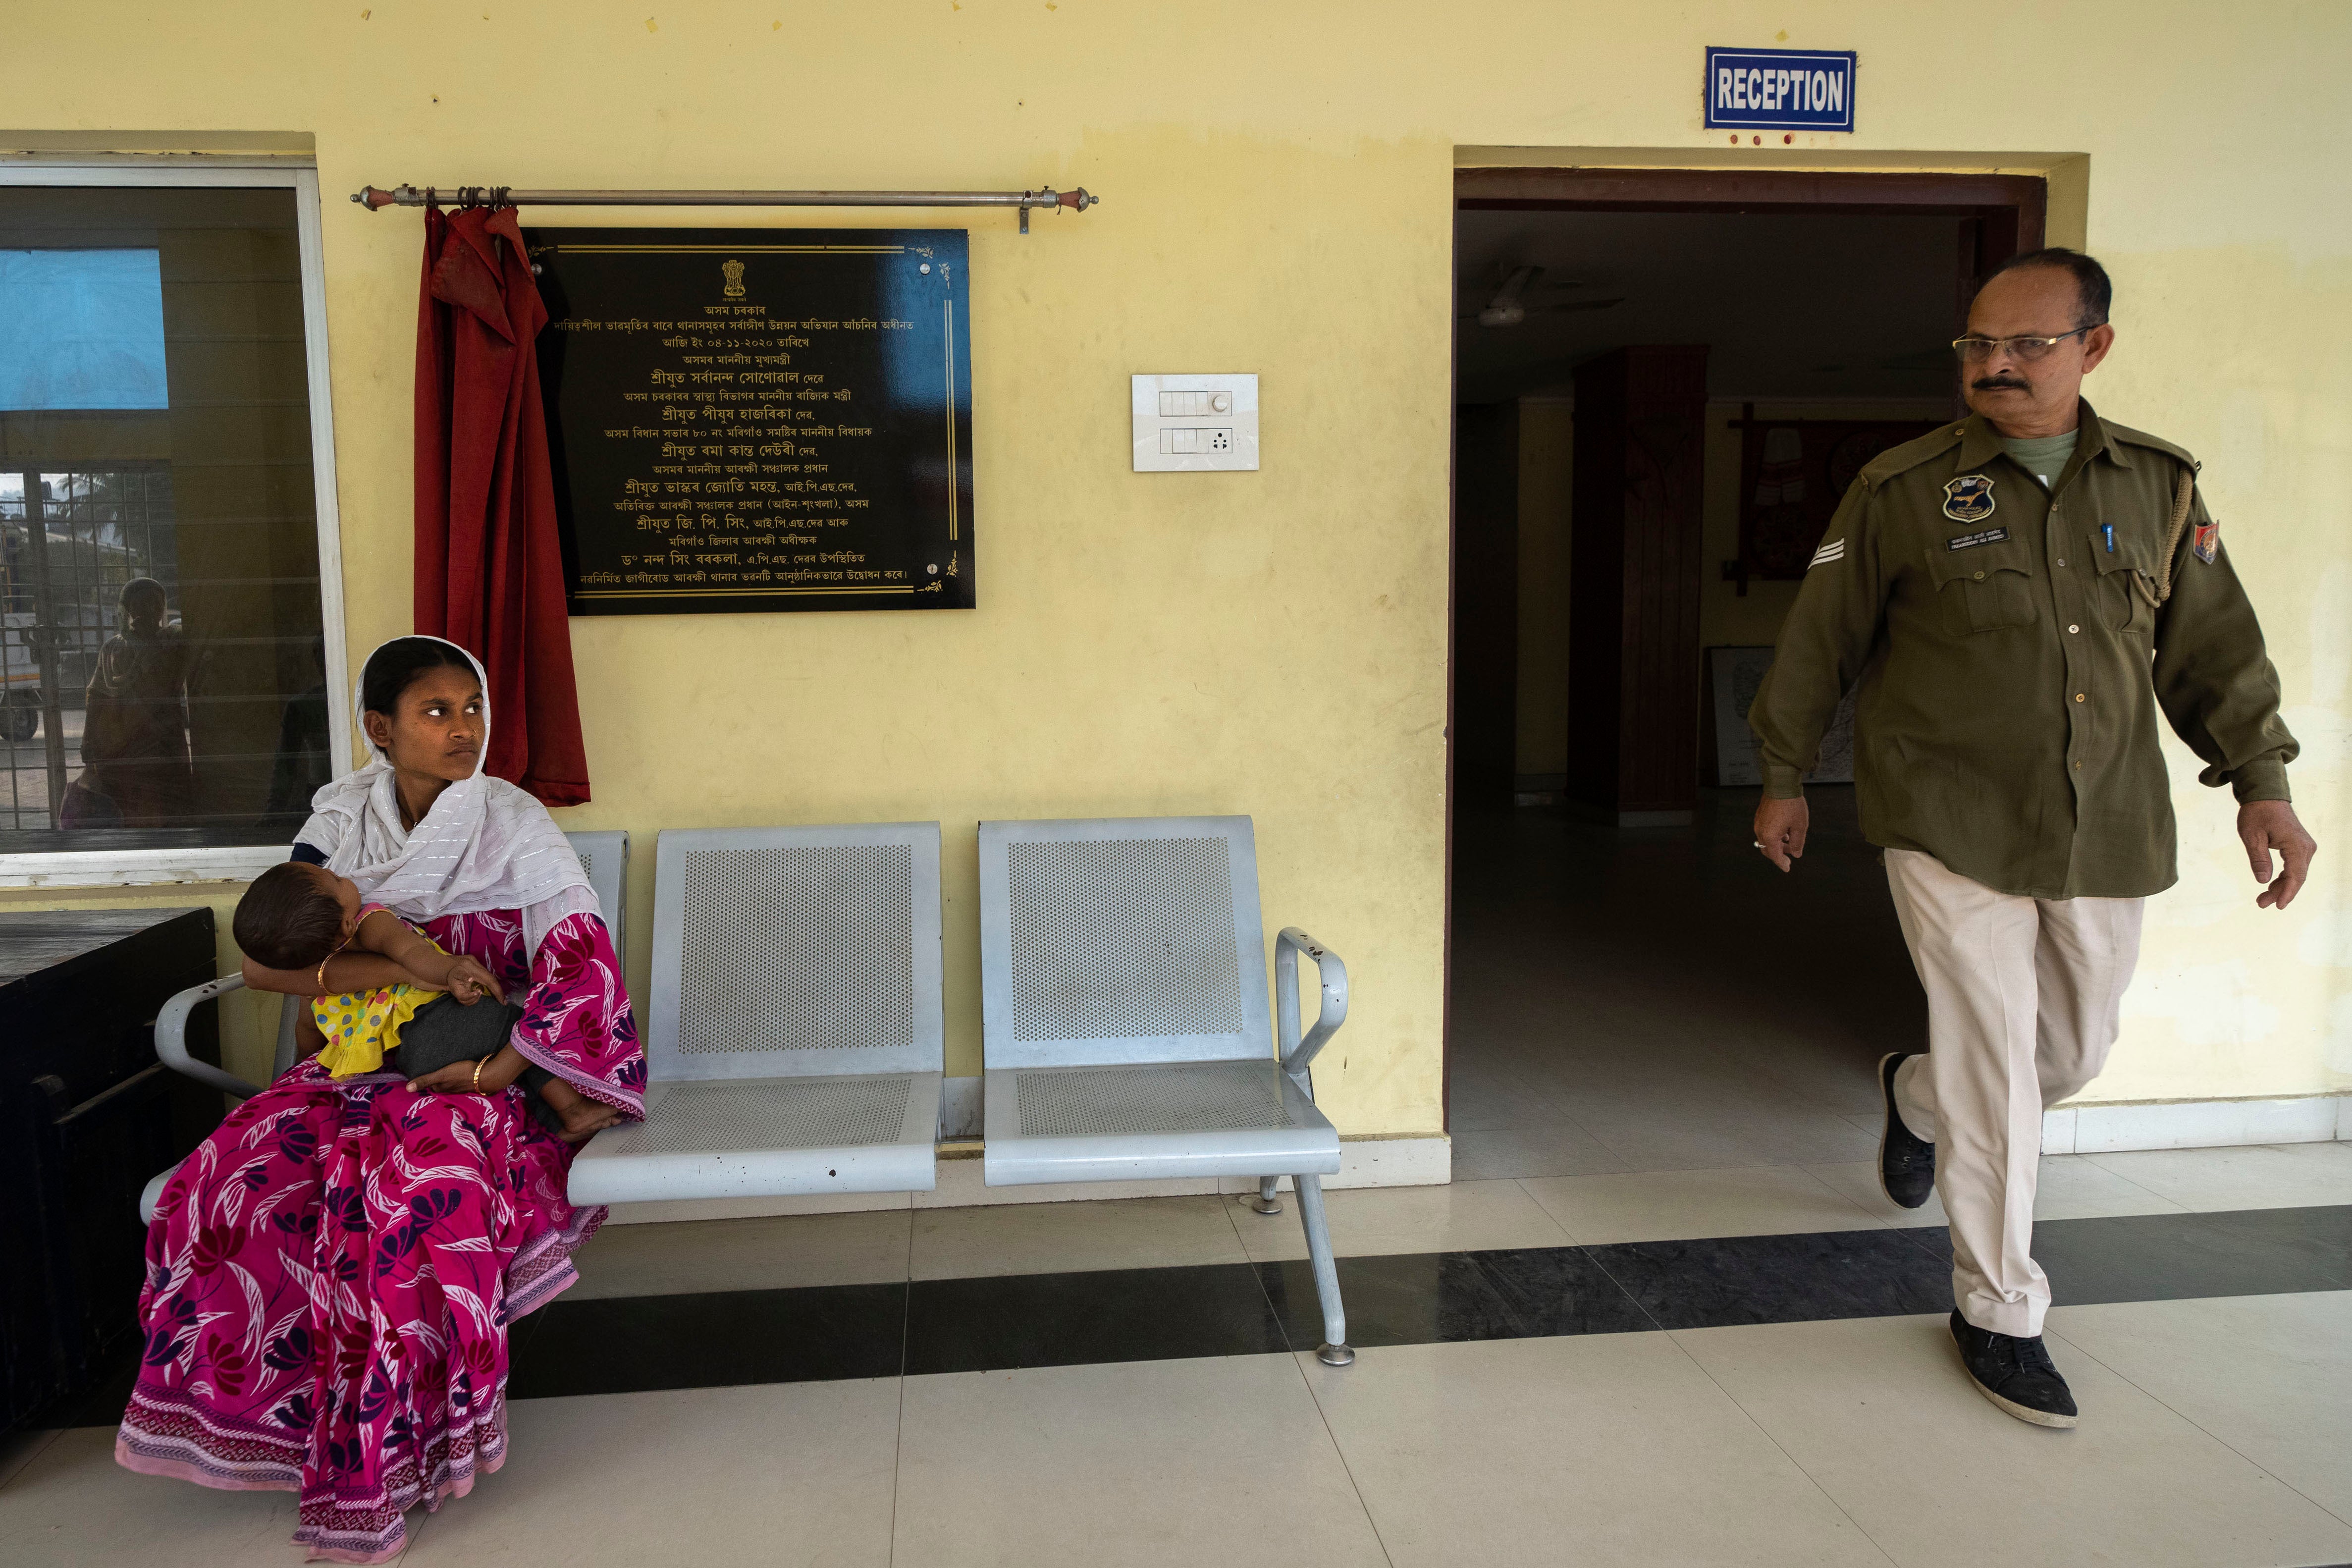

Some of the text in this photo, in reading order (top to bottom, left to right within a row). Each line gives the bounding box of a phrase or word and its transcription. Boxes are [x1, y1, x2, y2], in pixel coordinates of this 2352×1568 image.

[1717, 68, 1844, 111] RECEPTION
[703, 305, 766, 316] অসম চৰকাৰ
[604, 318, 649, 334] ভাৱমূৰ্তিৰ
[677, 321, 725, 334] থানাসমূহৰ
[767, 319, 797, 330] উন্নয়ন
[800, 318, 839, 330] অভিযান
[841, 318, 877, 330] আঁচনিৰ
[880, 318, 914, 330] অধীনত
[662, 334, 809, 349] আজি ইং ০৪-১১-২০২০ তাৰিখে
[682, 352, 791, 368] অসমৰ মাননীয় মুখ্যমন্ত্ৰী
[650, 369, 686, 388] শ্ৰীযুত
[690, 369, 734, 384] সৰ্বানন্দ
[739, 371, 800, 384] সোণোৱাল
[623, 388, 852, 402] অসম চৰকাৰৰ স্বাস্থ্য বিভাগৰ মাননীয় ৰাজ্যিক মন্ত্ৰী
[661, 405, 697, 425] শ্ৰীযুত
[738, 404, 792, 421] হাজৰিকা
[796, 411, 814, 421] দেৱ,
[603, 424, 872, 438] অসম বিধান সভাৰ ৮০ নং মৰিগাঁও সমষ্টিৰ মাননীয় বিধায়ক
[661, 440, 818, 461] শ্ৰীযুত ৰমা কান্ত দেউৰী দেৱ,
[651, 466, 683, 475] অসমৰ
[686, 462, 721, 475] মাননীয়
[724, 462, 758, 474] আৰক্ষী
[803, 463, 828, 473] প্ৰধান
[624, 479, 660, 498] শ্ৰীযুত
[663, 481, 700, 493] ভাস্কৰ
[705, 477, 745, 493] জ্যোতি
[748, 481, 780, 494] মহন্ত,
[613, 498, 655, 511] অতিৰিক্ত
[658, 498, 692, 511] আৰক্ষী
[738, 500, 763, 510] প্ৰধান
[844, 499, 869, 508] অসম
[636, 515, 671, 534] শ্ৰীযুত
[675, 514, 695, 530] জি.
[700, 513, 719, 530] পি.
[724, 513, 748, 530] সিং,
[826, 518, 849, 528] আৰু
[668, 533, 817, 547] মৰিগাঁও জিলাৰ আৰক্ষী অধীক্ষক
[642, 555, 665, 566] নন্দ
[669, 549, 690, 566] সিং
[695, 552, 741, 566] বৰকলা,
[794, 555, 816, 564] দেৱৰ
[819, 550, 865, 564] উপস্থিতিত
[580, 571, 621, 584] নৱনিৰ্মিত
[672, 570, 706, 583] আৰক্ষী
[710, 572, 738, 582] থানাৰ
[740, 569, 771, 582] ভৱনটি
